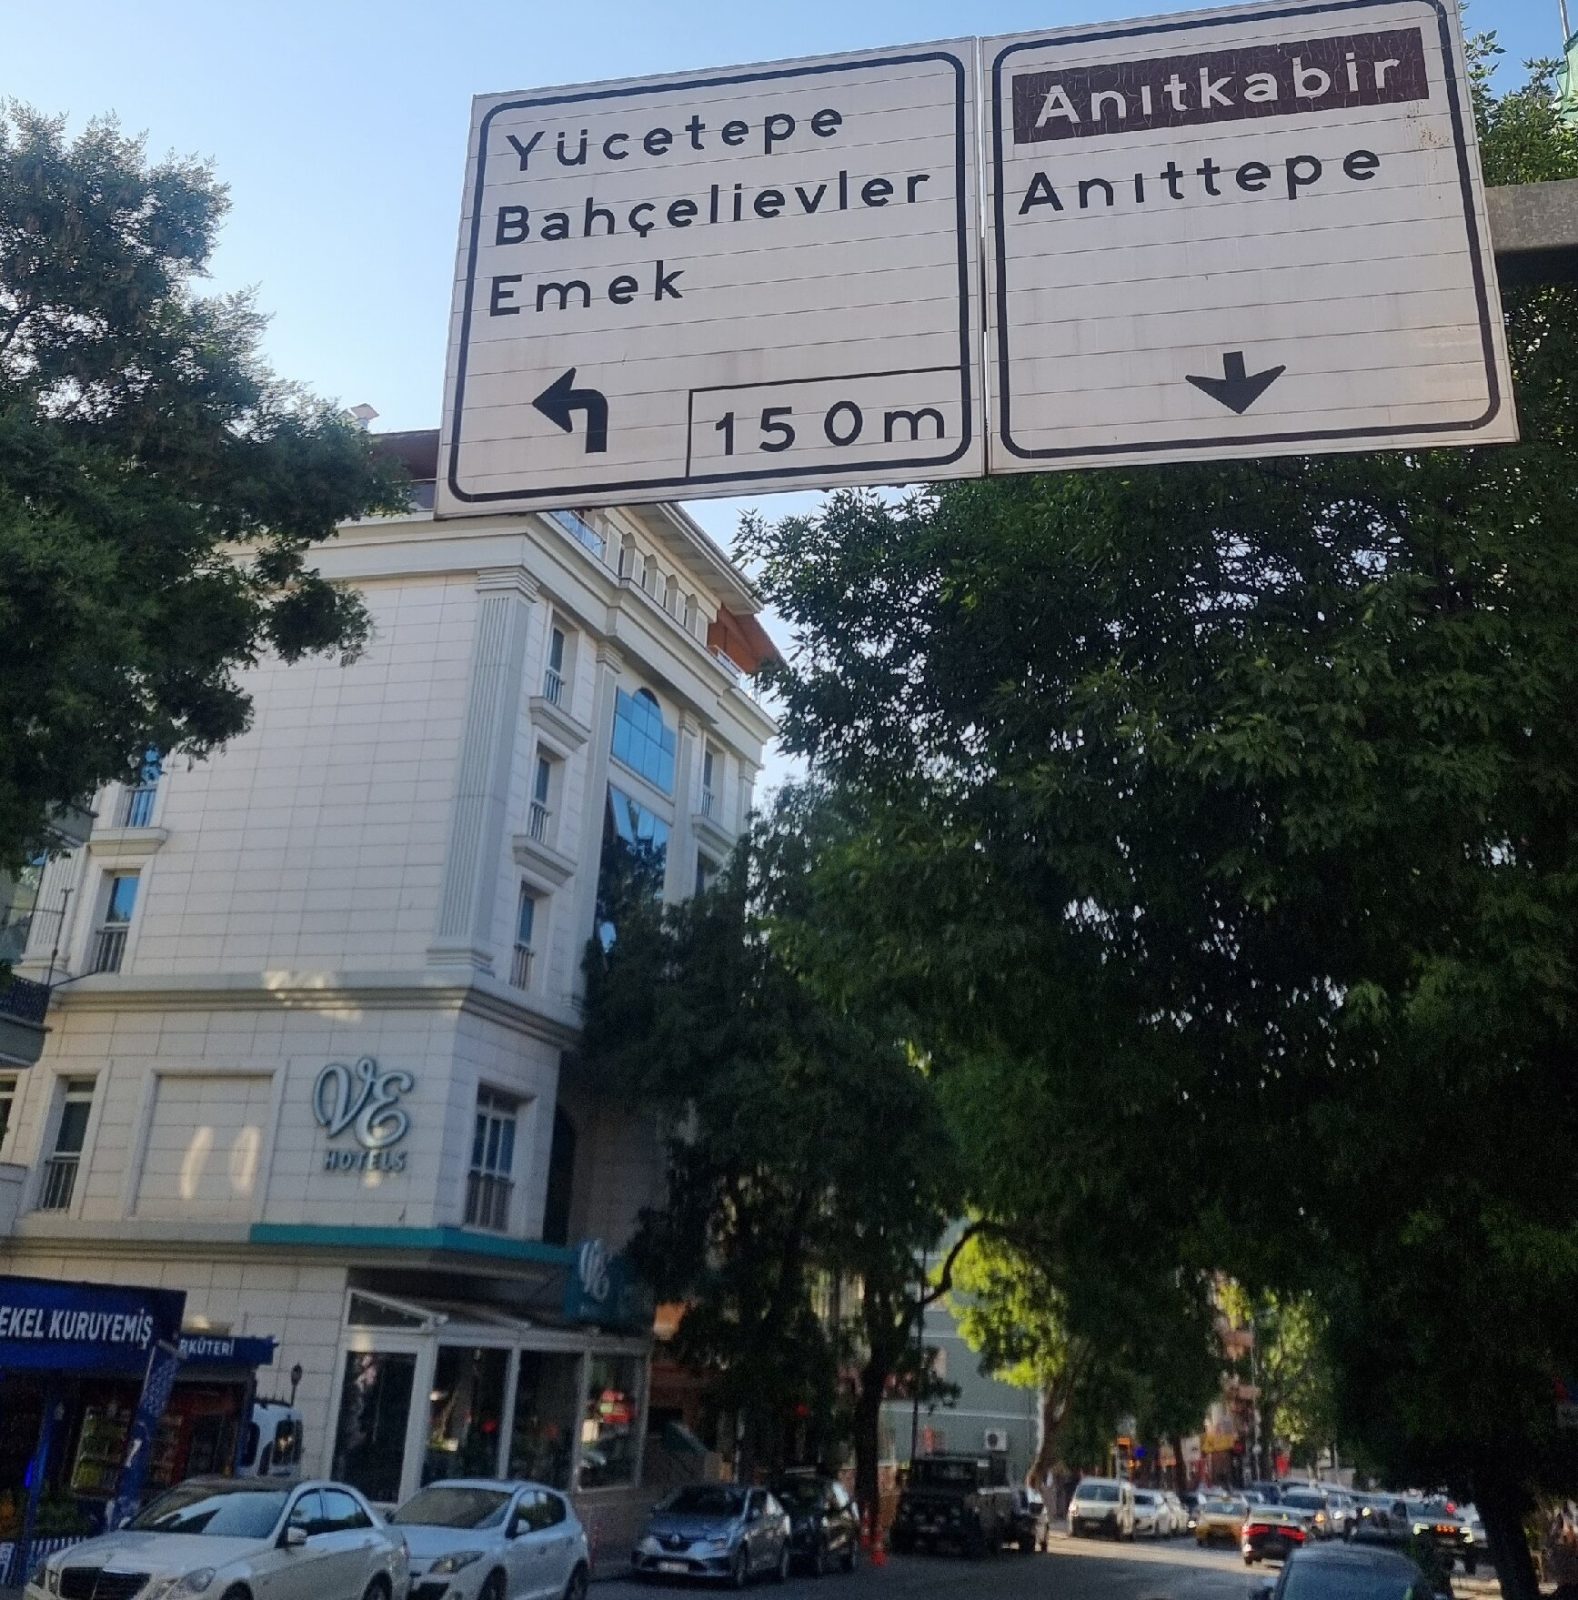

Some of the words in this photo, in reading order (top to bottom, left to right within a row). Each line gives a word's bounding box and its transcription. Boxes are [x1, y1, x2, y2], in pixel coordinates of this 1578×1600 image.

[1035, 52, 1400, 128] Anıtkabir
[506, 108, 843, 172] Yücetepe
[496, 171, 931, 246] Bahçelievler
[1018, 149, 1381, 215] Anıttepe
[490, 260, 685, 317] Emek
[325, 1150, 408, 1172] HOTELS
[48, 1308, 154, 1350] KURUYEMİŞ
